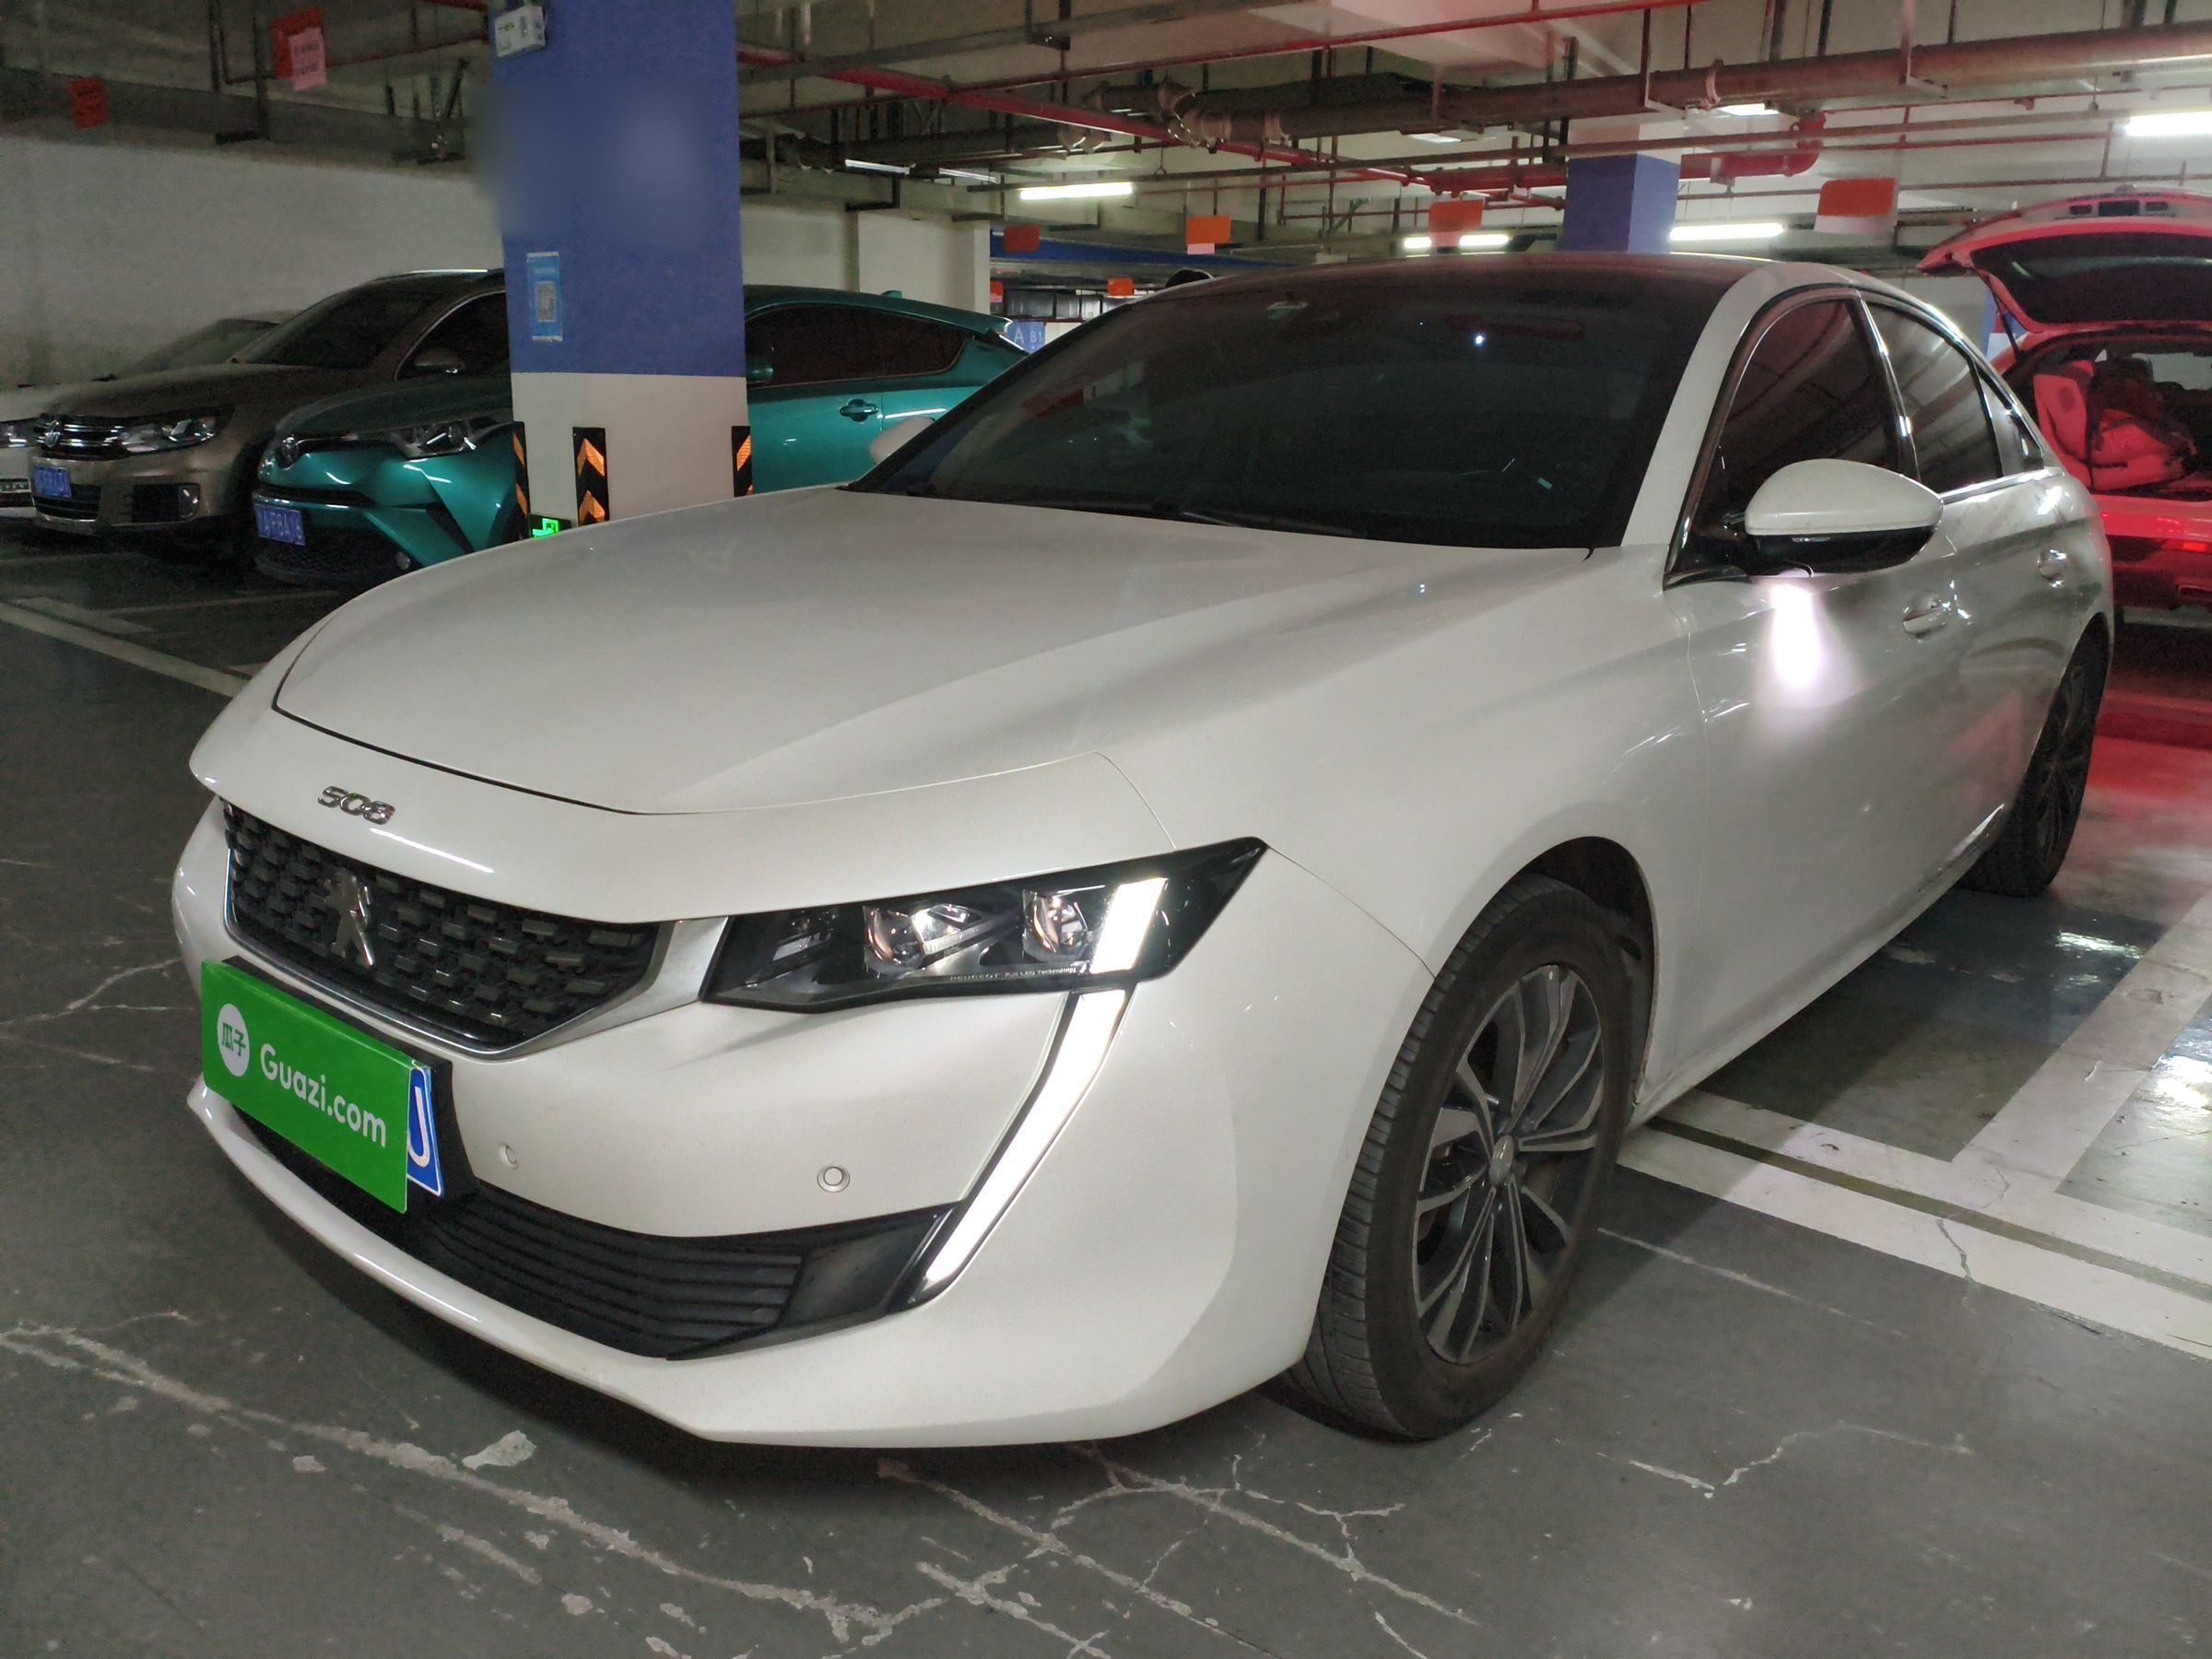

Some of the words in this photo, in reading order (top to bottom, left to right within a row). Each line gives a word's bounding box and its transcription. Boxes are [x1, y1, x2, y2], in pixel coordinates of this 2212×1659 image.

[1014, 327, 1025, 345] A
[317, 785, 395, 825] 508
[221, 1022, 246, 1057] 瓜子
[260, 1042, 387, 1148] Guazi.com
